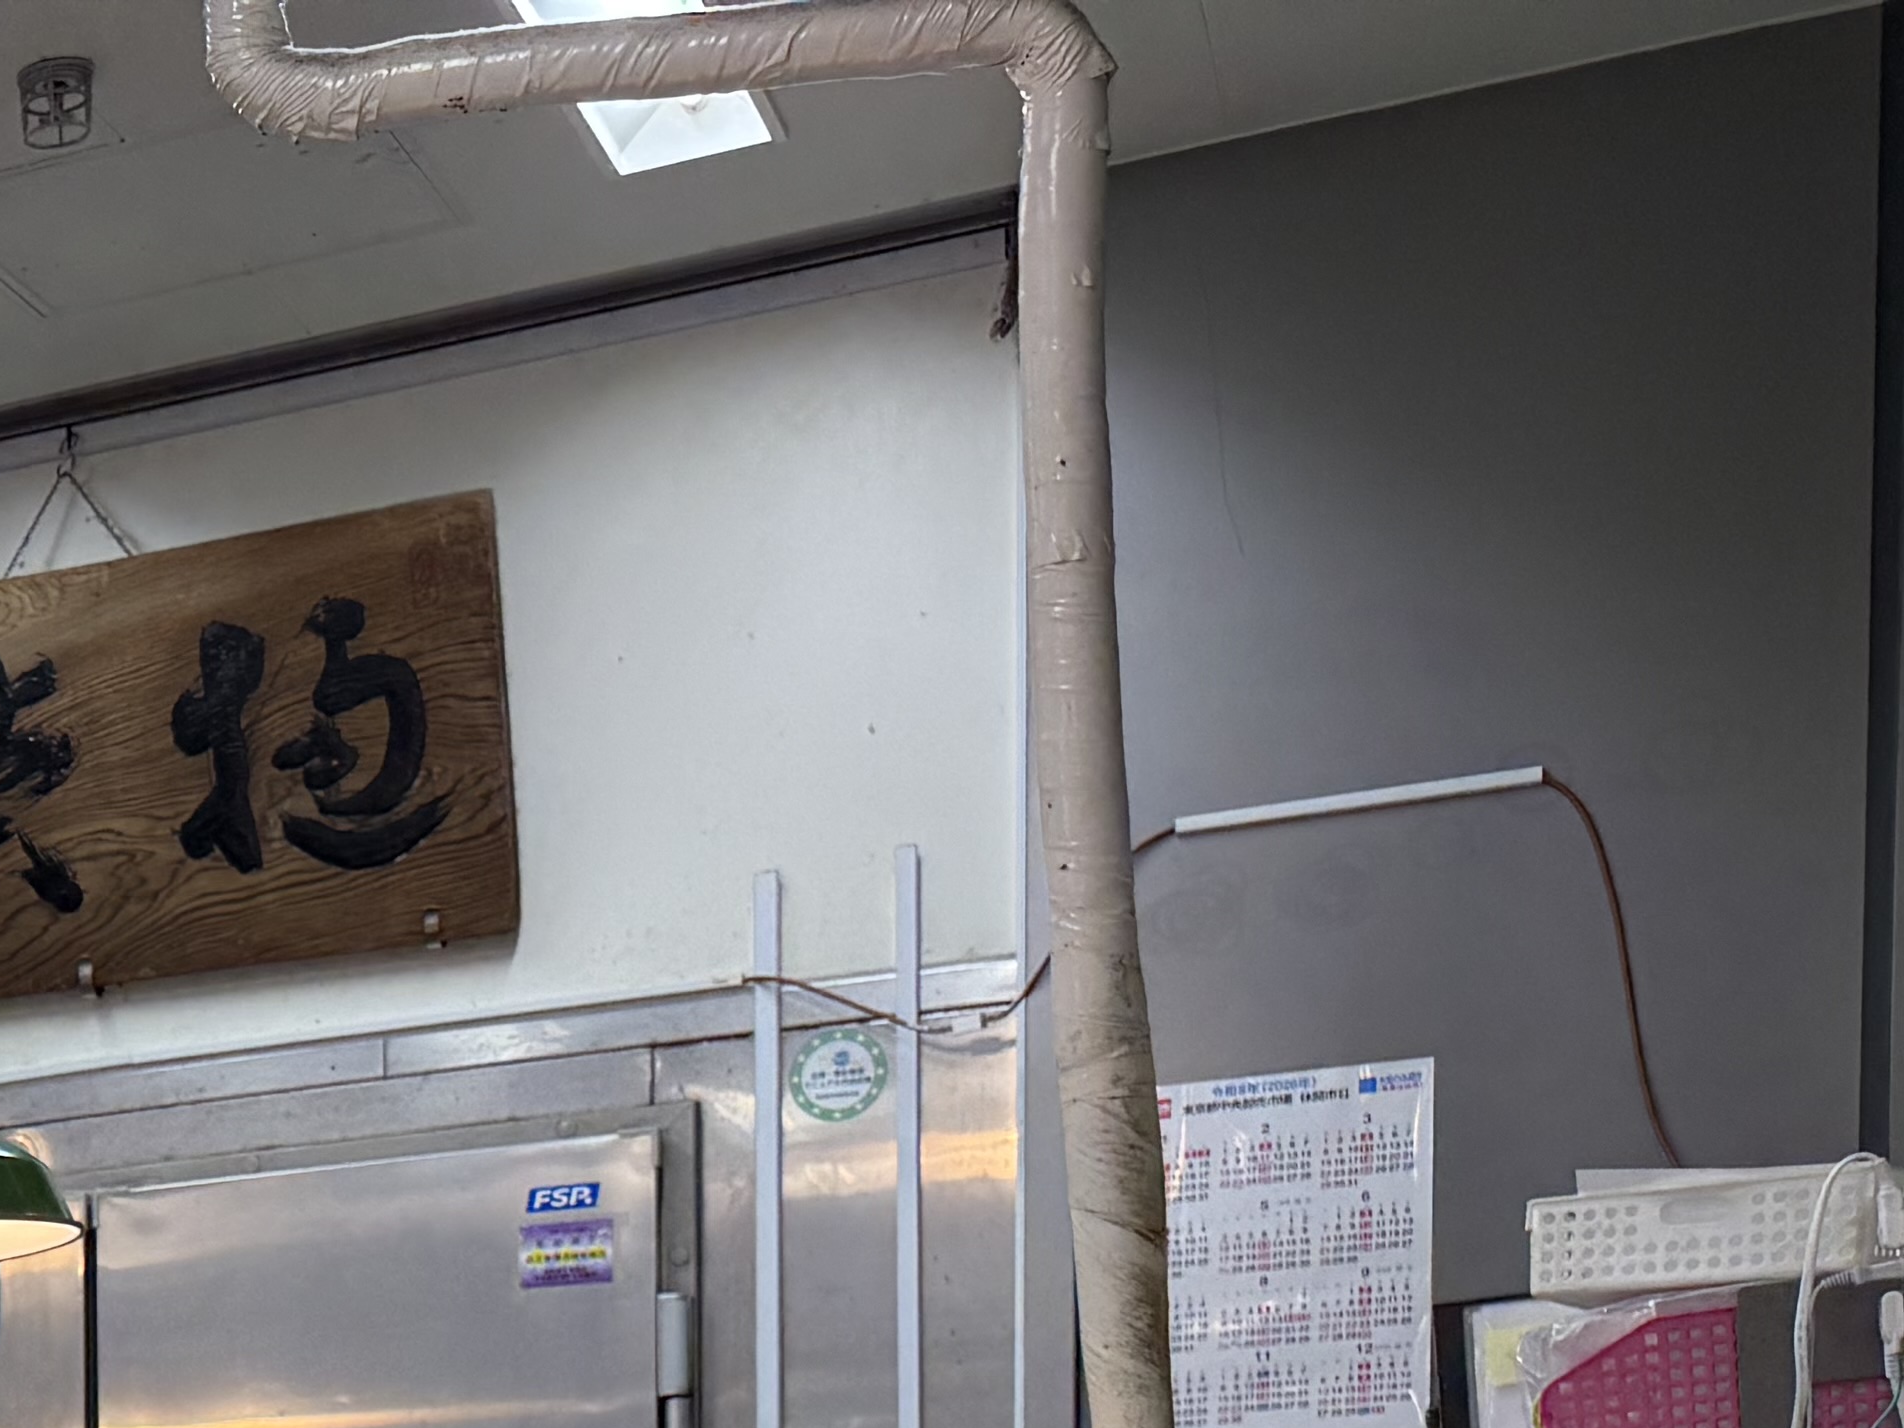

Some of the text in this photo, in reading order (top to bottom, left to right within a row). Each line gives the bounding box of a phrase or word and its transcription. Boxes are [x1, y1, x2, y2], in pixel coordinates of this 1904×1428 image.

[1363, 1113, 1371, 1124] 3
[1261, 1124, 1270, 1133] 2
[1356, 1343, 1373, 1355] 12
[1255, 1351, 1271, 1362] 11
